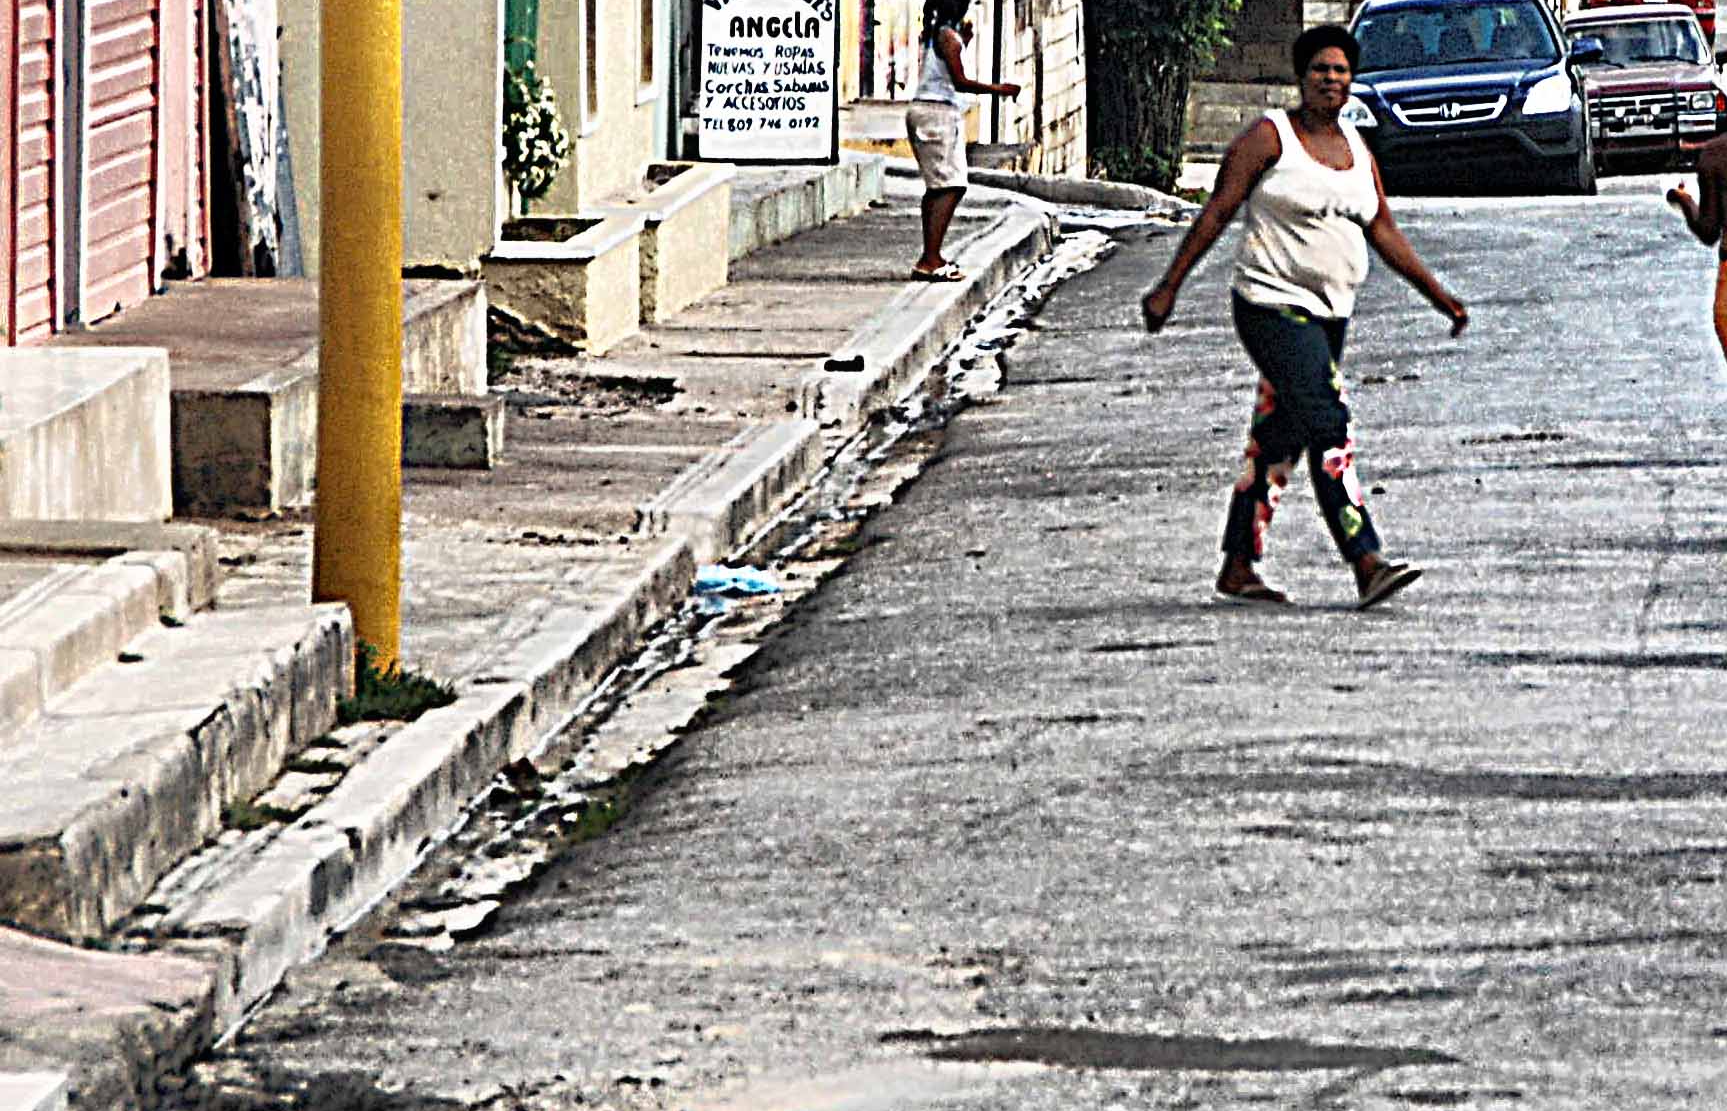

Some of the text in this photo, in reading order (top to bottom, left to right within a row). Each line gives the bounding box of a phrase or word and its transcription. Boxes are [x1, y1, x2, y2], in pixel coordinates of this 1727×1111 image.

[763, 61, 771, 75] Y
[705, 96, 714, 109] Y
[727, 117, 753, 132] 809
